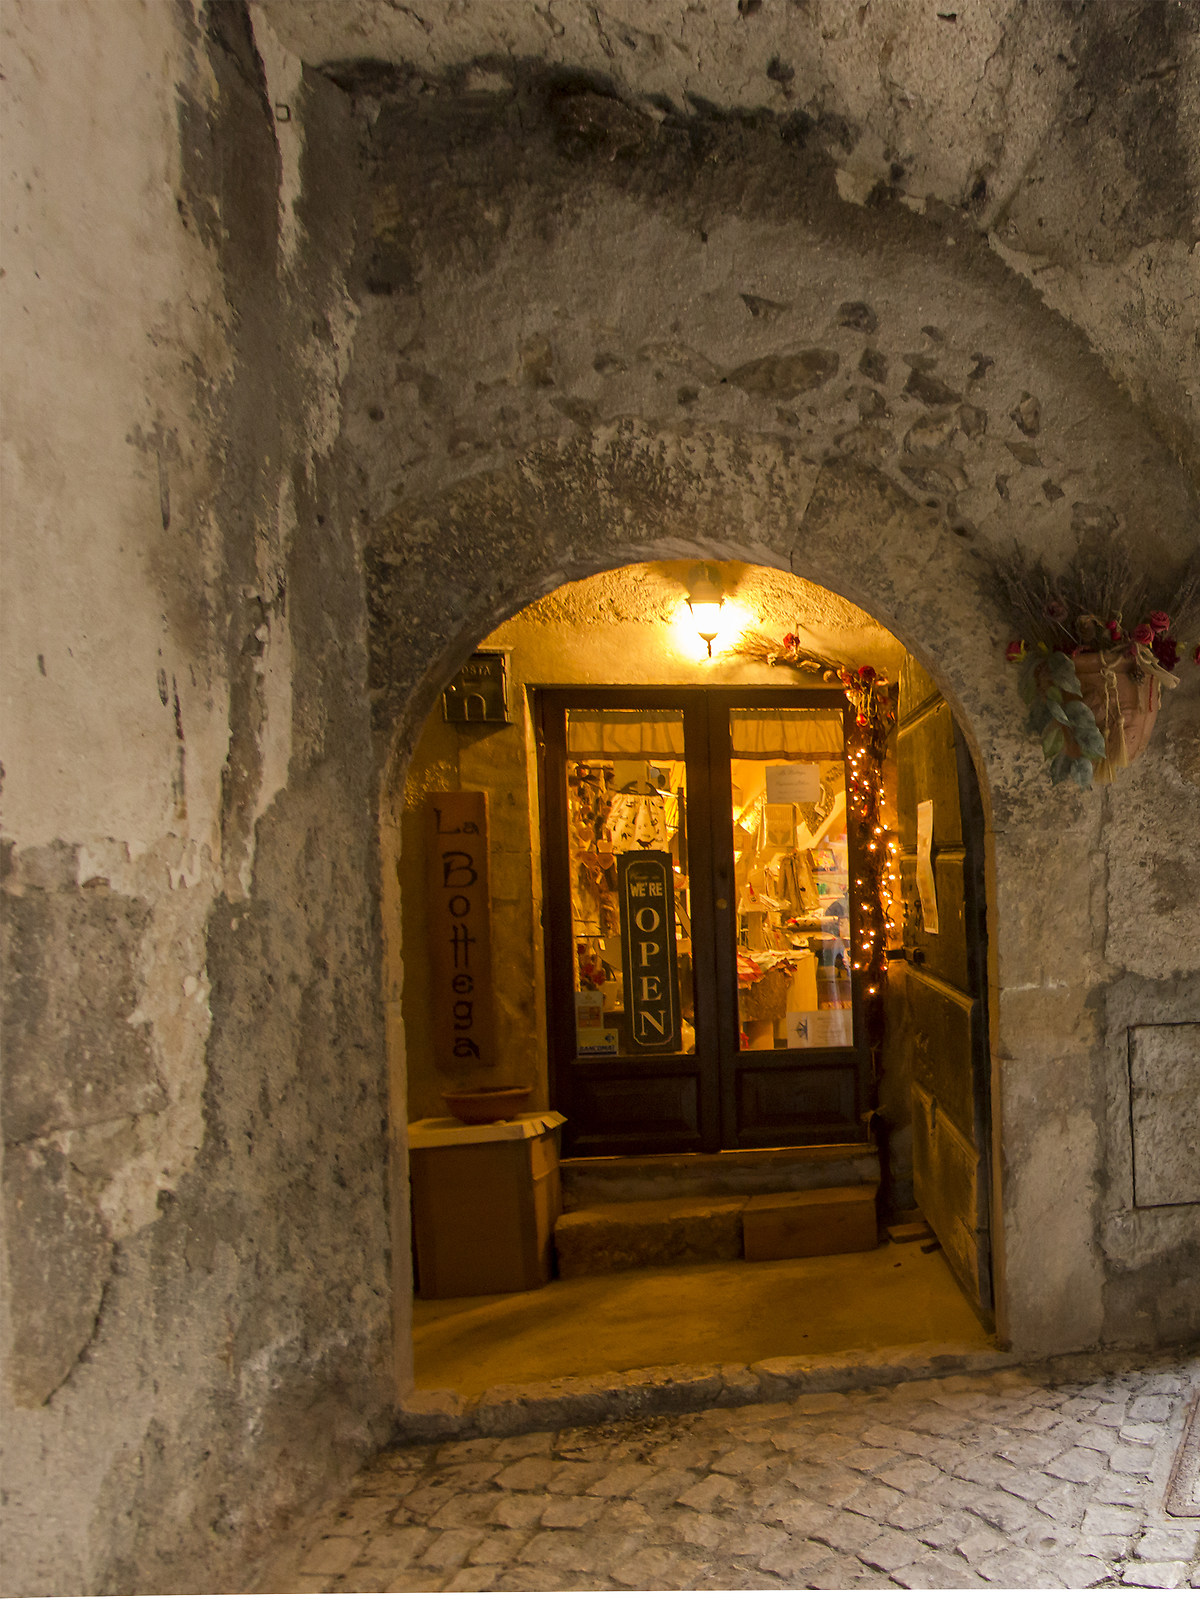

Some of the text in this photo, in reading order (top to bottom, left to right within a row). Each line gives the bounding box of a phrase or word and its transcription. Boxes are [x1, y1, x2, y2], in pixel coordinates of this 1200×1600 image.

[433, 807, 480, 835] La
[629, 881, 664, 898] WE'RE
[442, 850, 481, 1061] Bottega
[635, 906, 667, 1037] OPEN
